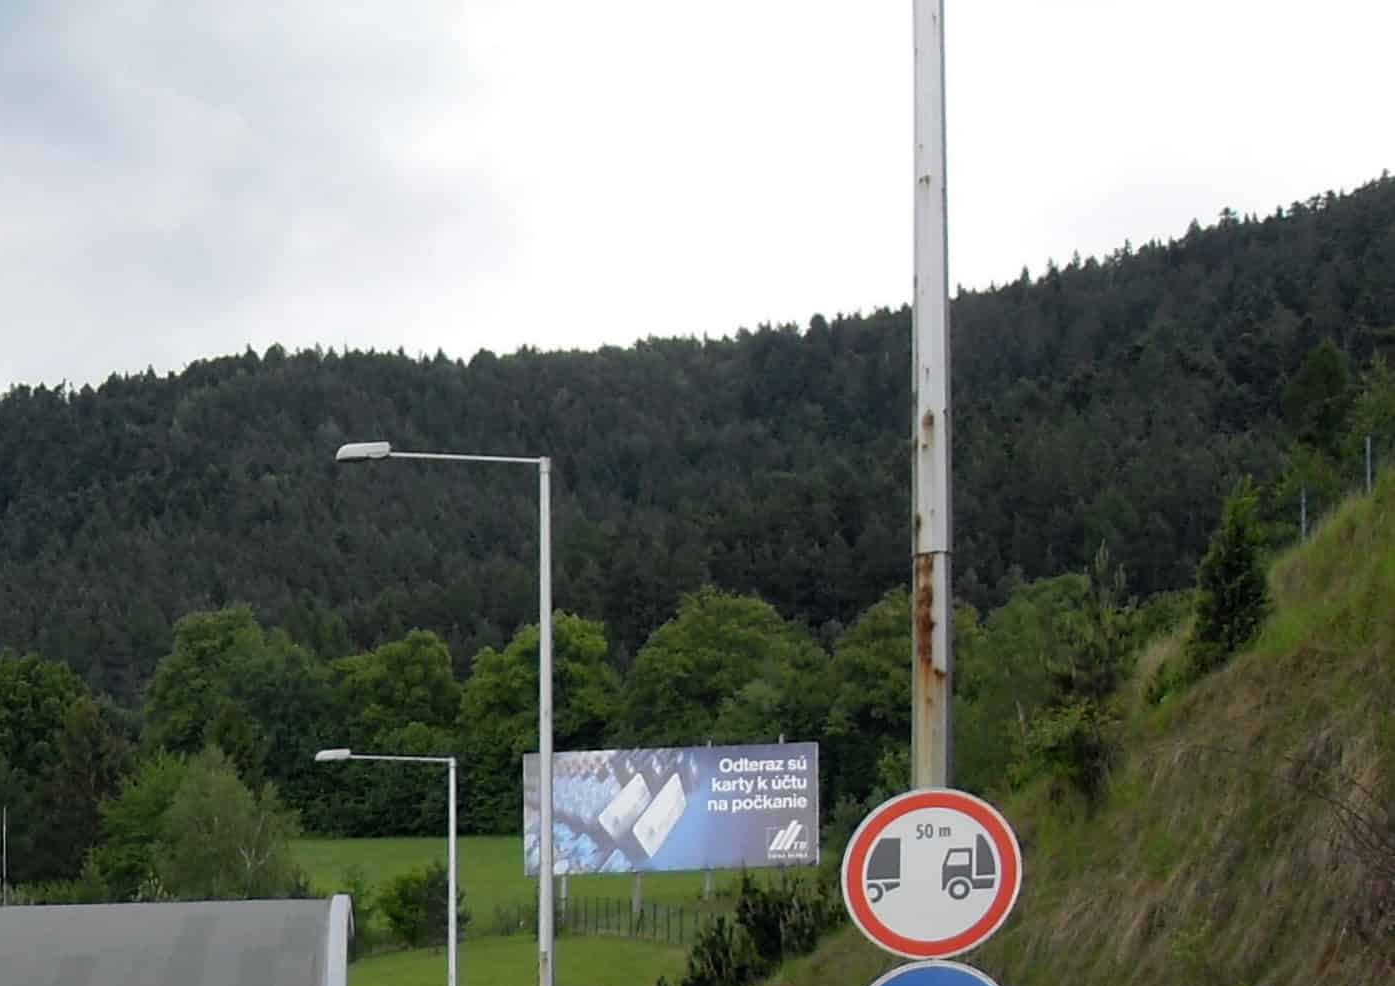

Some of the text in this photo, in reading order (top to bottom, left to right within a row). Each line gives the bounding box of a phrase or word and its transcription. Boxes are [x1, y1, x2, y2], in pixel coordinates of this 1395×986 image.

[719, 755, 807, 773] Odteraz sú
[711, 774, 807, 794] karty k účtu
[707, 793, 807, 813] na počkanie
[916, 823, 951, 840] 50 m
